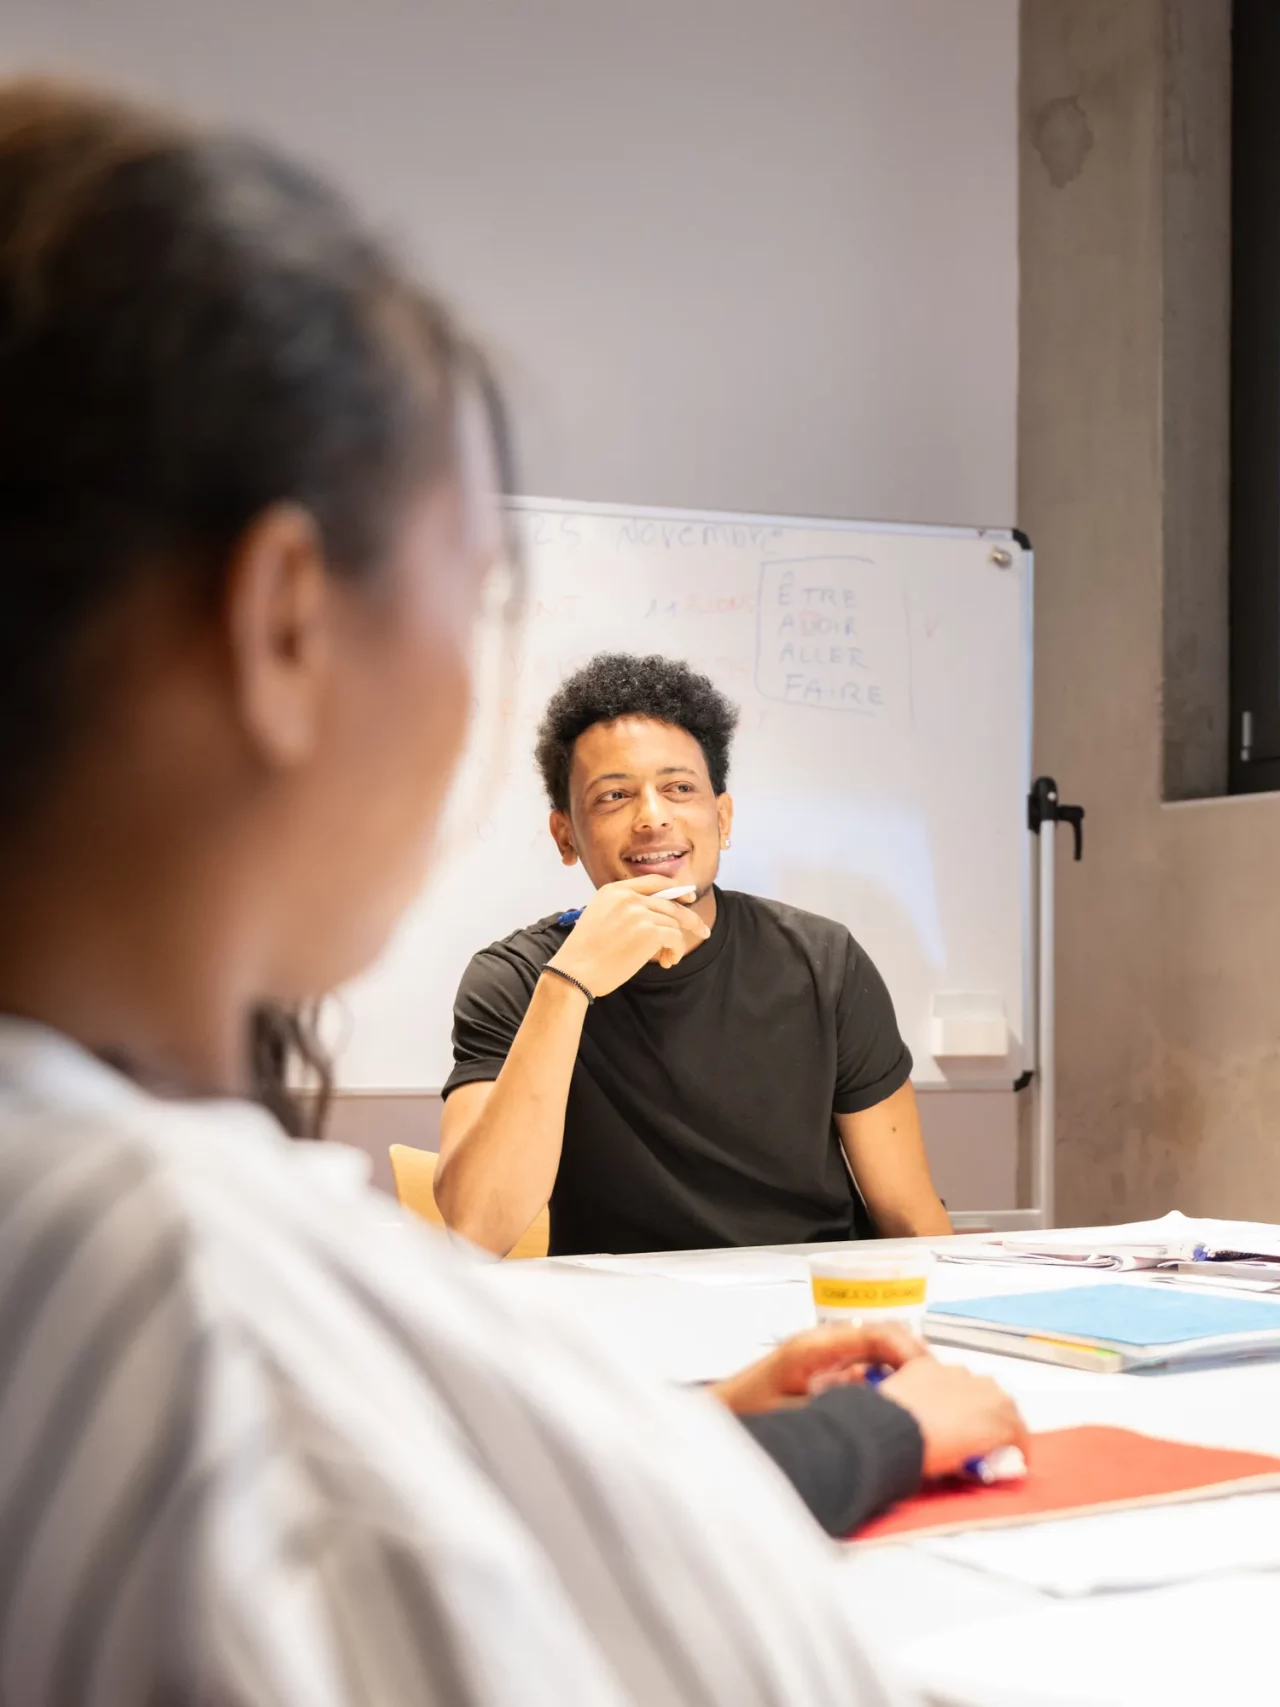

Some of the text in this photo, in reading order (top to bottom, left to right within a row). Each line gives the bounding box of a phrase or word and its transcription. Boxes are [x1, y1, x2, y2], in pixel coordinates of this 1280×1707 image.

[533, 519, 582, 551] 25
[779, 641, 869, 670] ALLER
[783, 673, 885, 705] FAIRE
